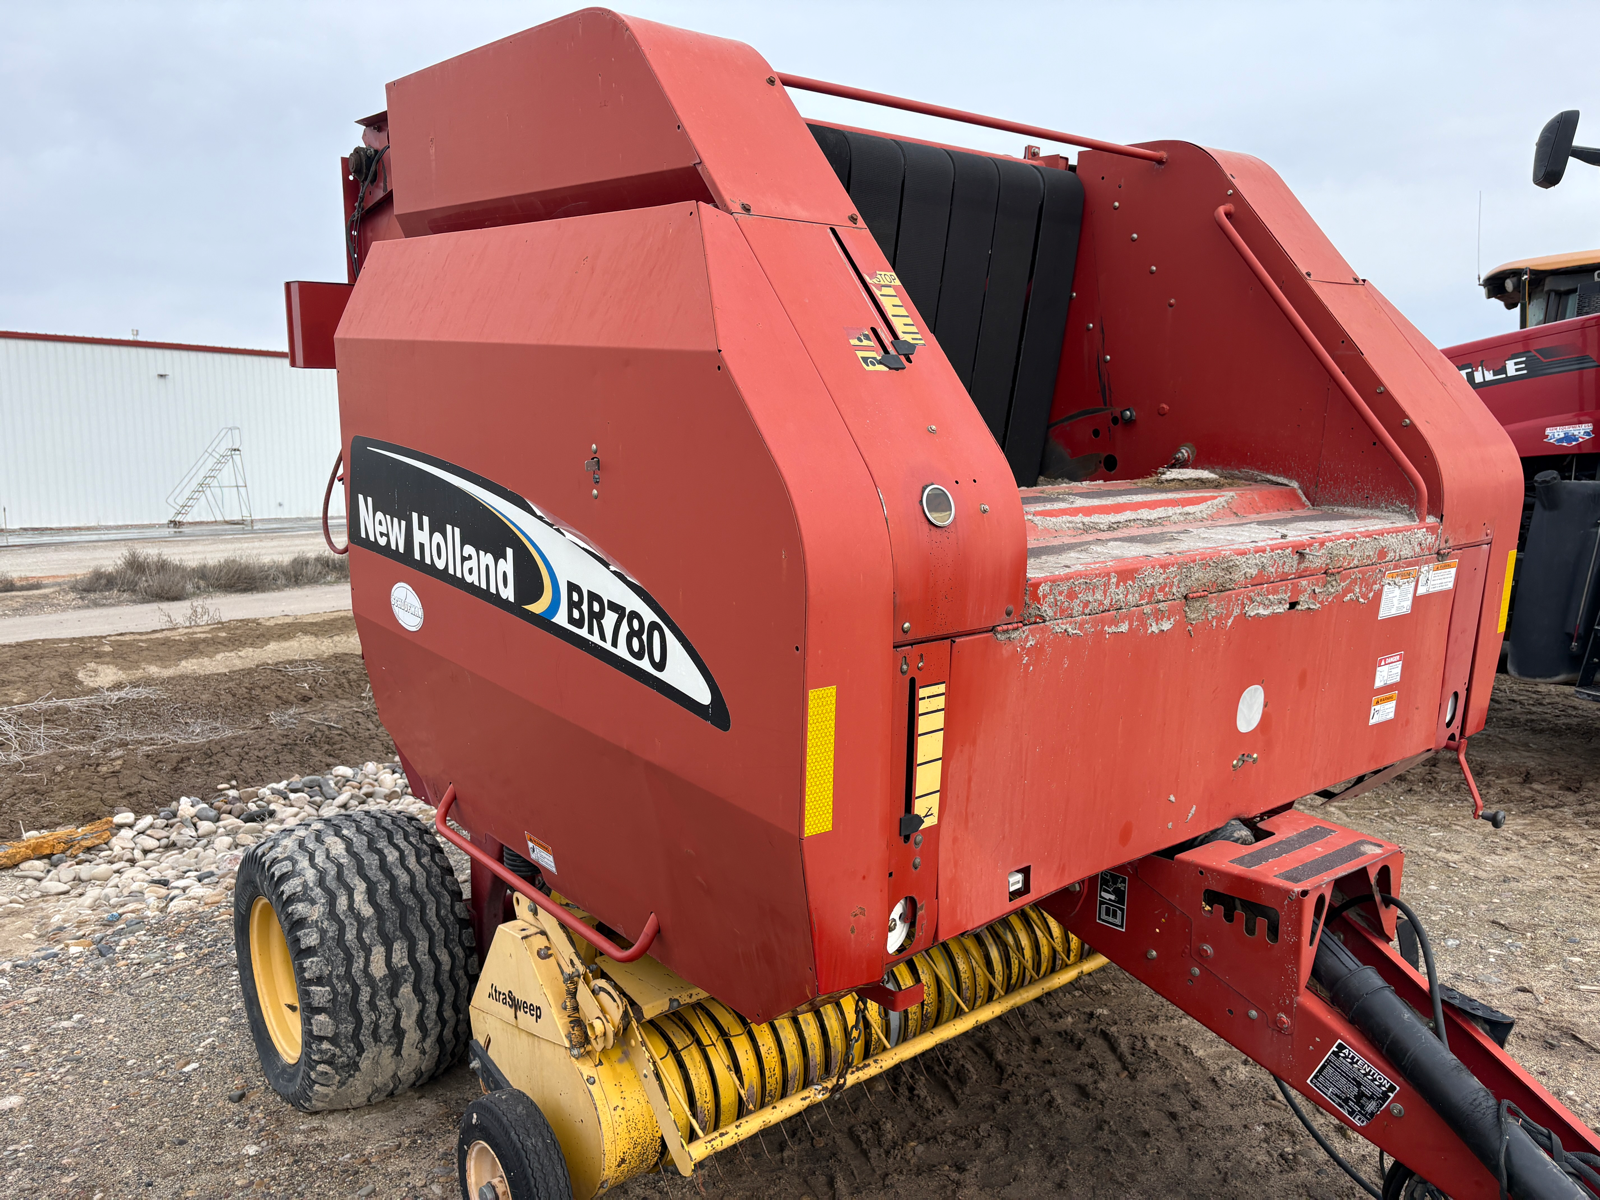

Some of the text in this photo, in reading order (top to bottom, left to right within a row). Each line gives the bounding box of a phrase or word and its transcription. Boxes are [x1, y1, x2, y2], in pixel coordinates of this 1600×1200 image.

[358, 493, 515, 602] New Holland
[566, 580, 668, 673] BR780
[1385, 655, 1400, 664] DANGER
[1341, 1048, 1391, 1088] ATTENTION
